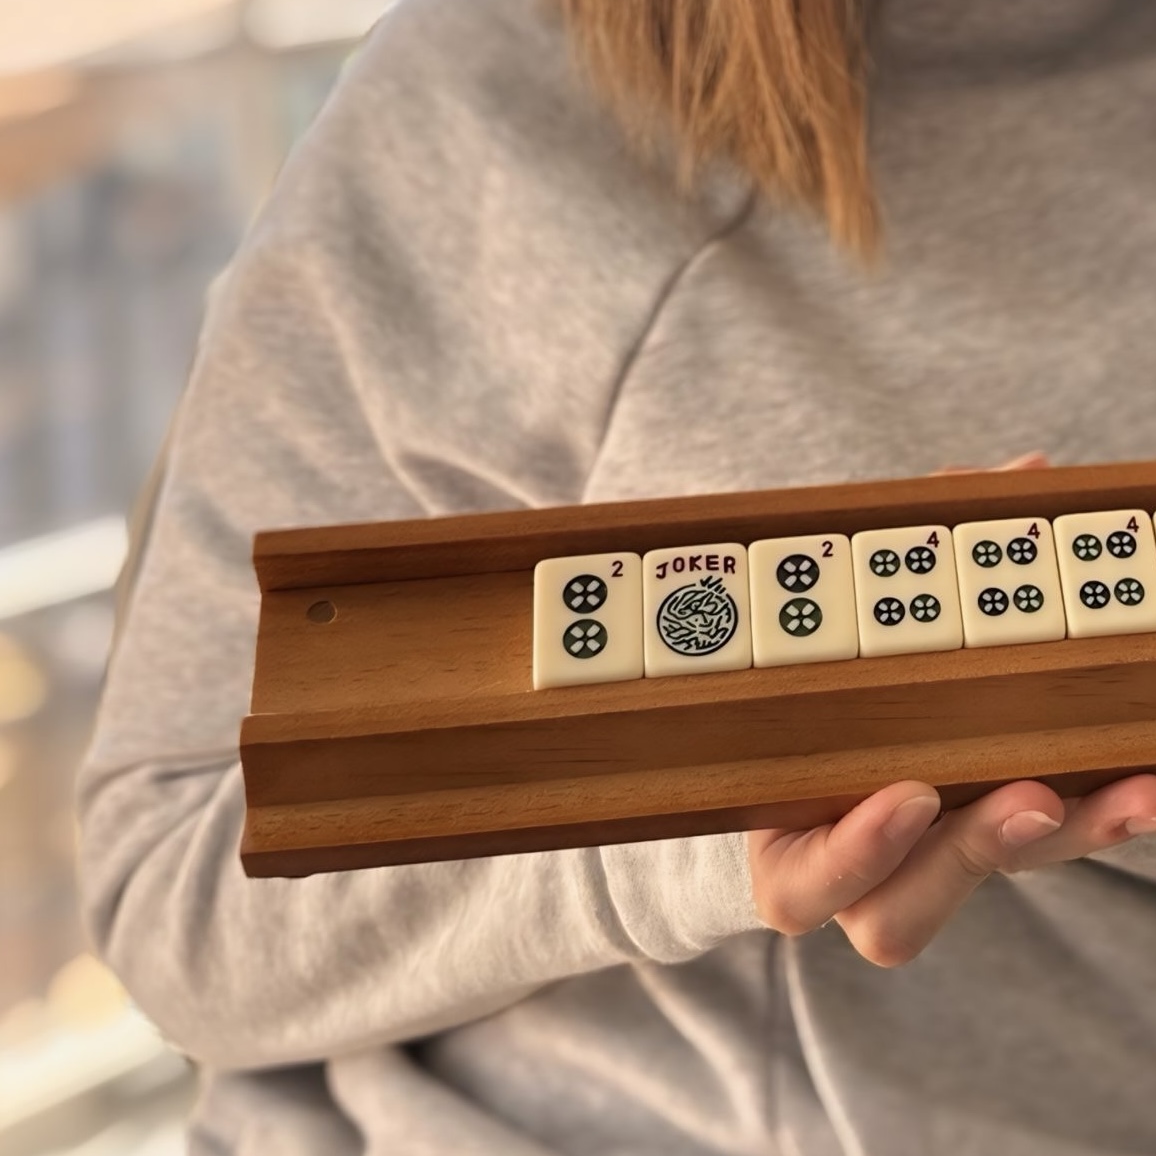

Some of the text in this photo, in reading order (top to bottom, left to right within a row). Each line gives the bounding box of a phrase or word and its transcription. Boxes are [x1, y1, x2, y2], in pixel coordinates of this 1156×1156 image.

[1027, 522, 1041, 540] 4
[1126, 515, 1140, 534] 4
[926, 530, 940, 548] 4
[821, 540, 834, 558] 2
[611, 560, 624, 578] 2
[655, 554, 736, 580] JOKER
